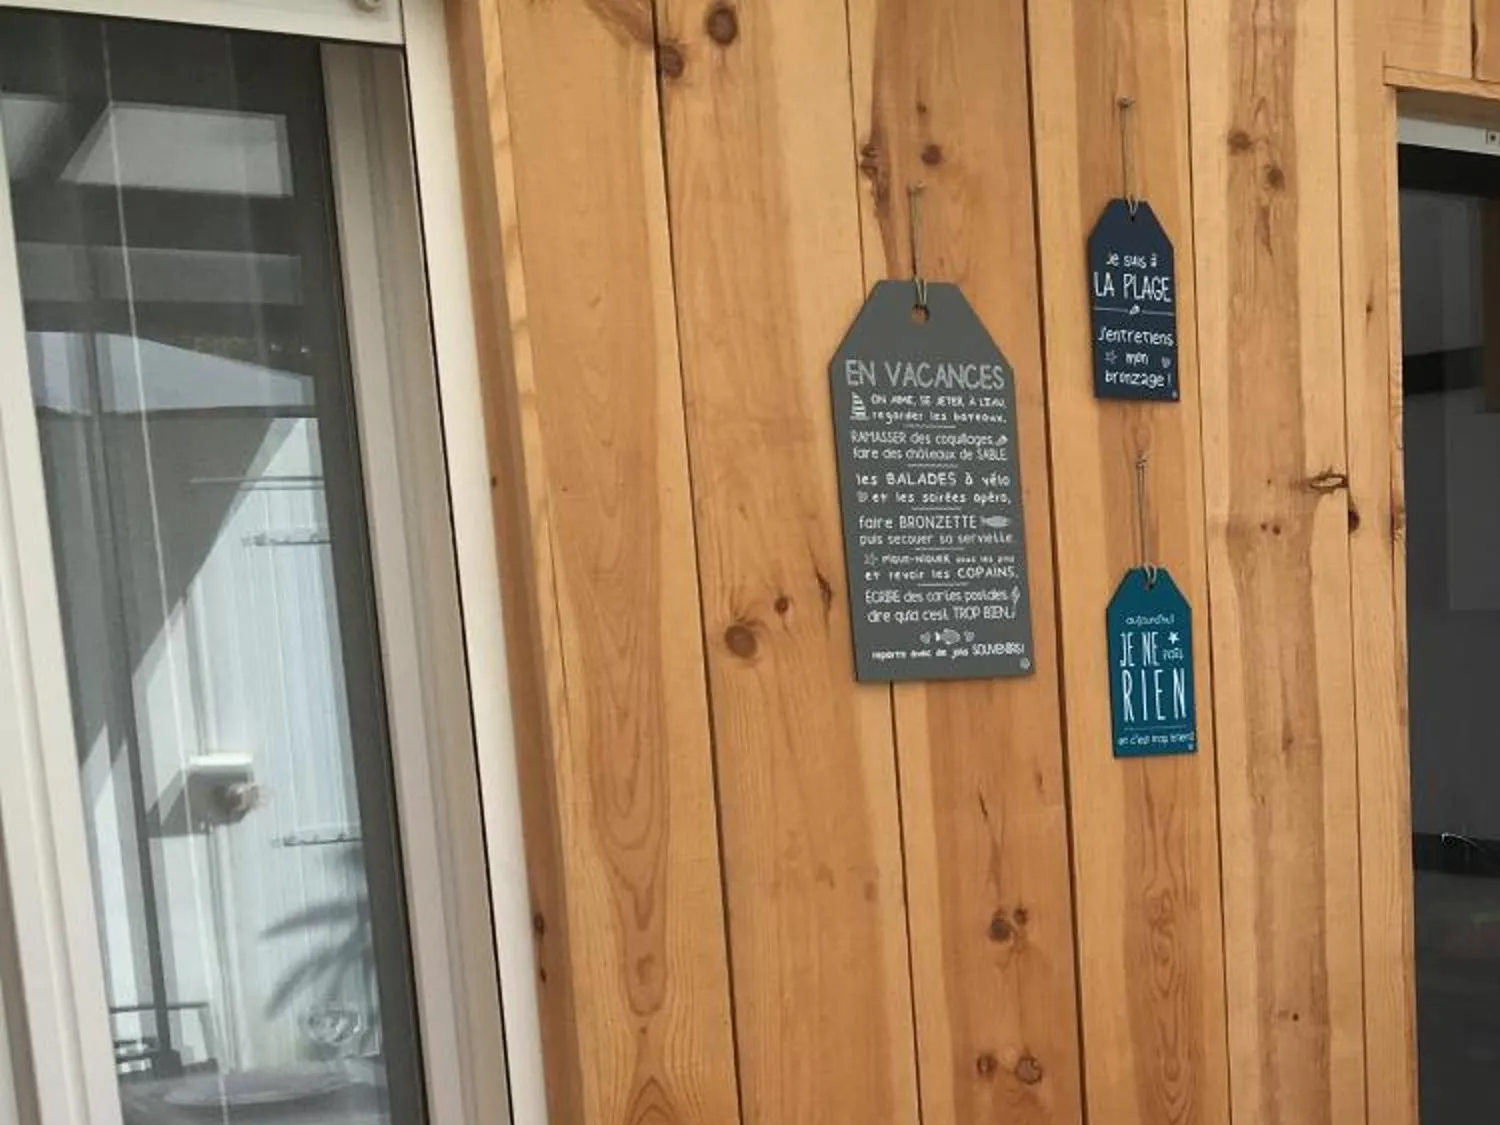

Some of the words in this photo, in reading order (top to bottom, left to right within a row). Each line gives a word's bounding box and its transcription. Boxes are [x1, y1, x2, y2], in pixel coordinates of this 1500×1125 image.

[1105, 252, 1119, 267] Je
[1123, 255, 1147, 269] suis
[1093, 271, 1115, 297] LA
[1123, 273, 1172, 303] PLAGE
[1125, 351, 1149, 366] mon
[845, 359, 877, 387] EN
[884, 360, 1005, 390] VACANCES
[872, 410, 924, 425] regarder
[929, 411, 947, 422] les
[851, 428, 907, 445] RAMASSER
[909, 431, 931, 445] des
[853, 447, 879, 460] faire
[882, 447, 903, 460] des
[959, 447, 973, 461] de
[976, 447, 1008, 461] SABLE
[855, 472, 878, 486] les
[885, 471, 957, 486] BALADES
[964, 471, 973, 486] à
[981, 472, 1010, 487] vélo
[871, 492, 888, 503] et
[896, 491, 915, 503] les
[922, 491, 966, 503] soirées
[859, 515, 893, 529] faire
[899, 514, 977, 529] BRONZETTE
[859, 534, 883, 546] puis
[887, 534, 932, 545] secouer
[939, 534, 953, 545] sa
[864, 571, 881, 581] et
[889, 570, 925, 580] revoir
[931, 568, 950, 579] les
[903, 590, 924, 603] des
[926, 590, 961, 602] cartes
[867, 608, 891, 623] dire
[953, 605, 981, 620] TROP
[1120, 631, 1135, 667] JE
[1141, 631, 1160, 667] NE
[1122, 667, 1187, 723] RIEN
